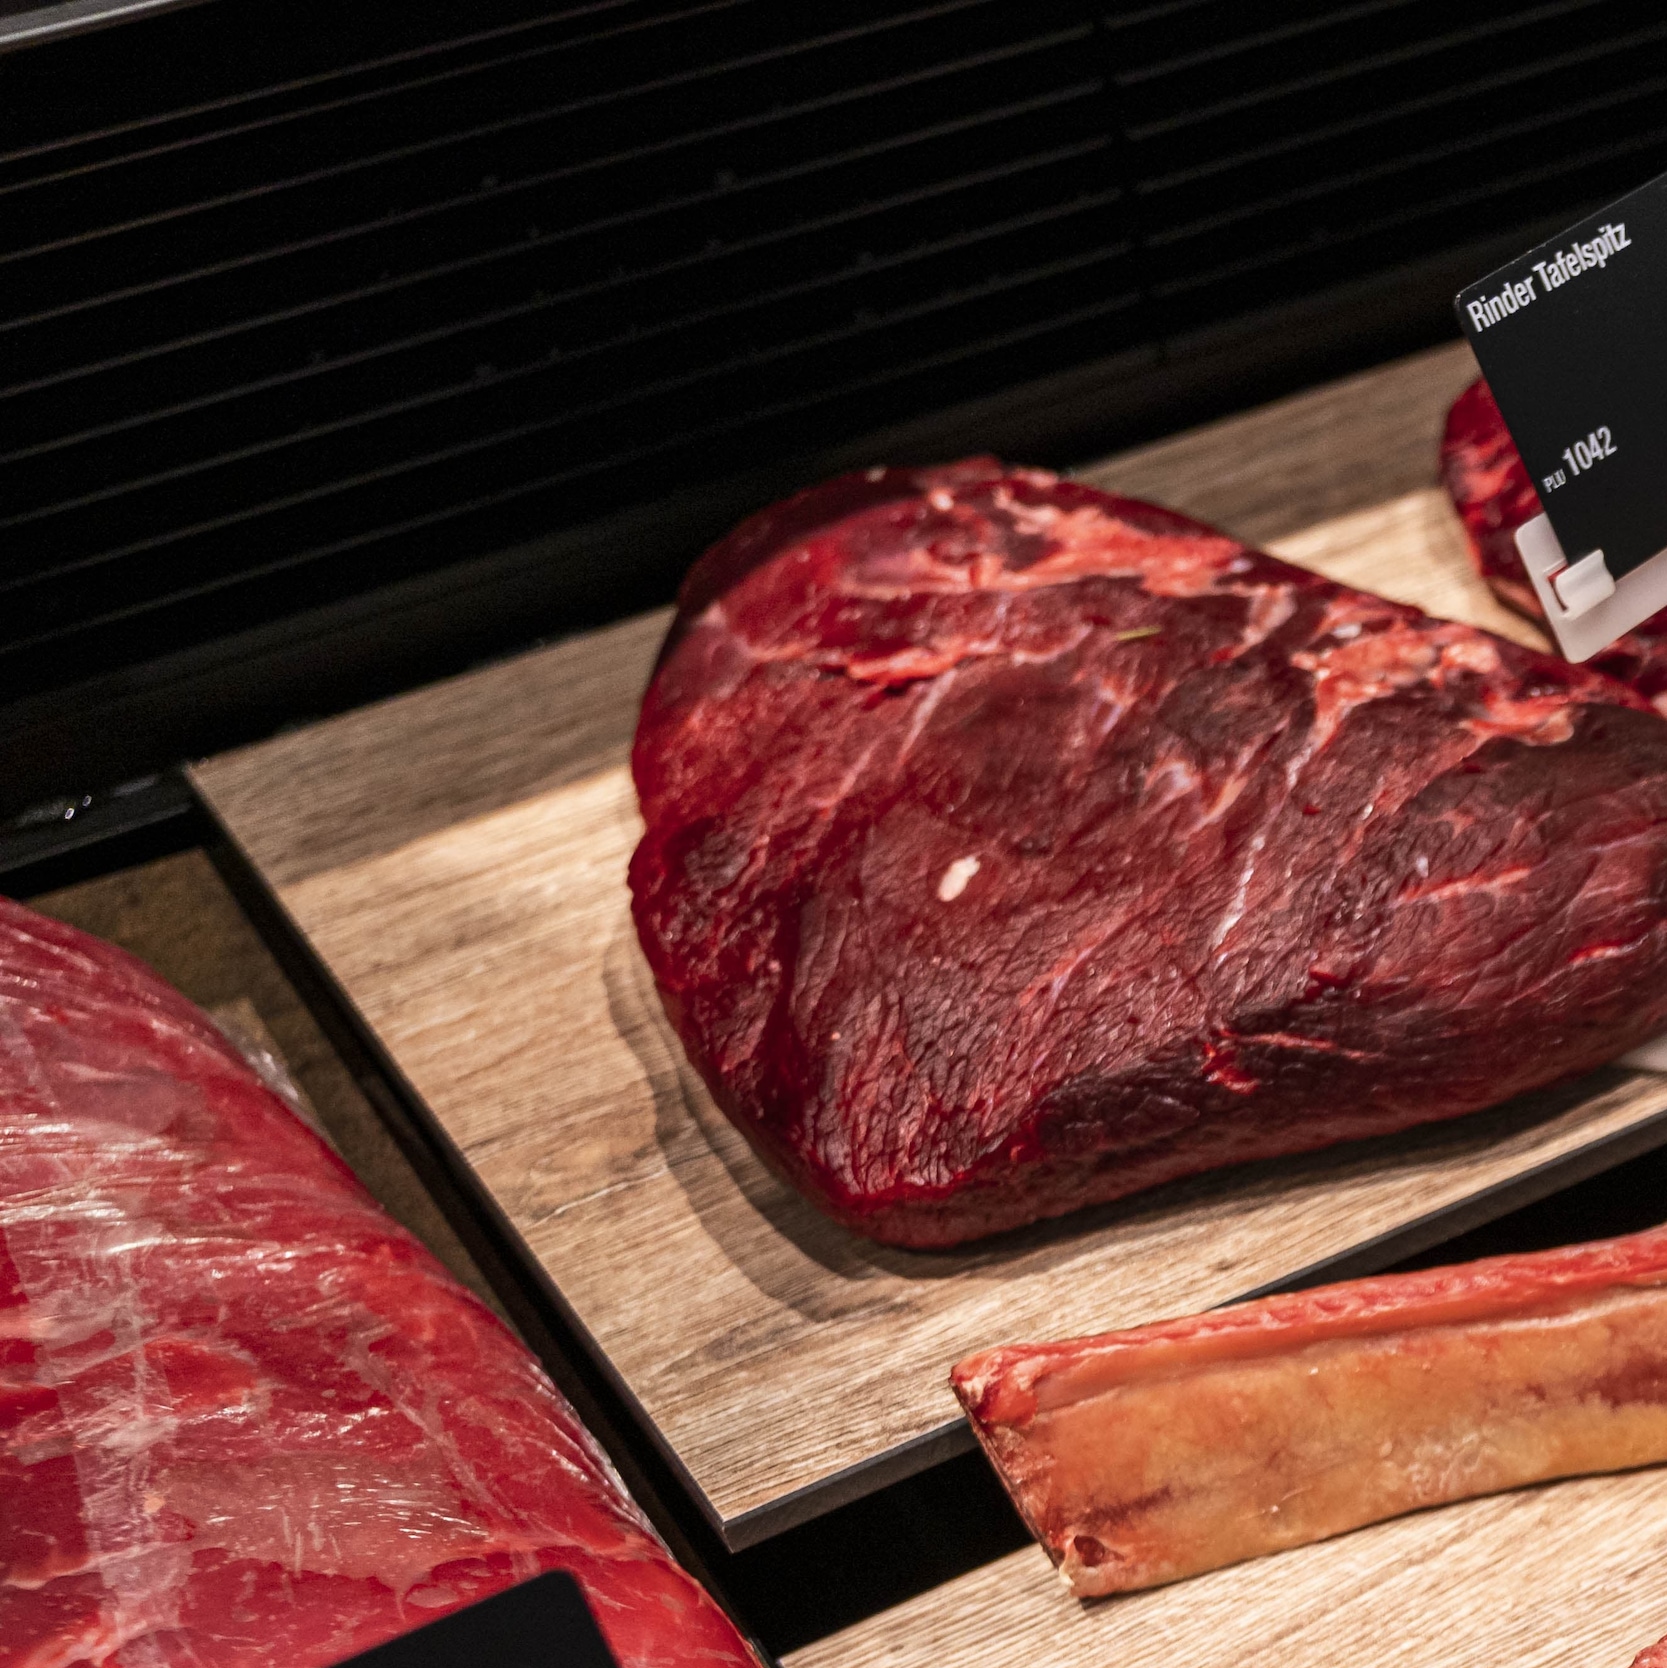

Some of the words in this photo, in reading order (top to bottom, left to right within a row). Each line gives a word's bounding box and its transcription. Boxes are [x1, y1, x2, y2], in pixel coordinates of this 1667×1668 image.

[1466, 276, 1537, 333] Rinder
[1532, 222, 1632, 293] Tafelspitz
[1562, 425, 1618, 477] 1042
